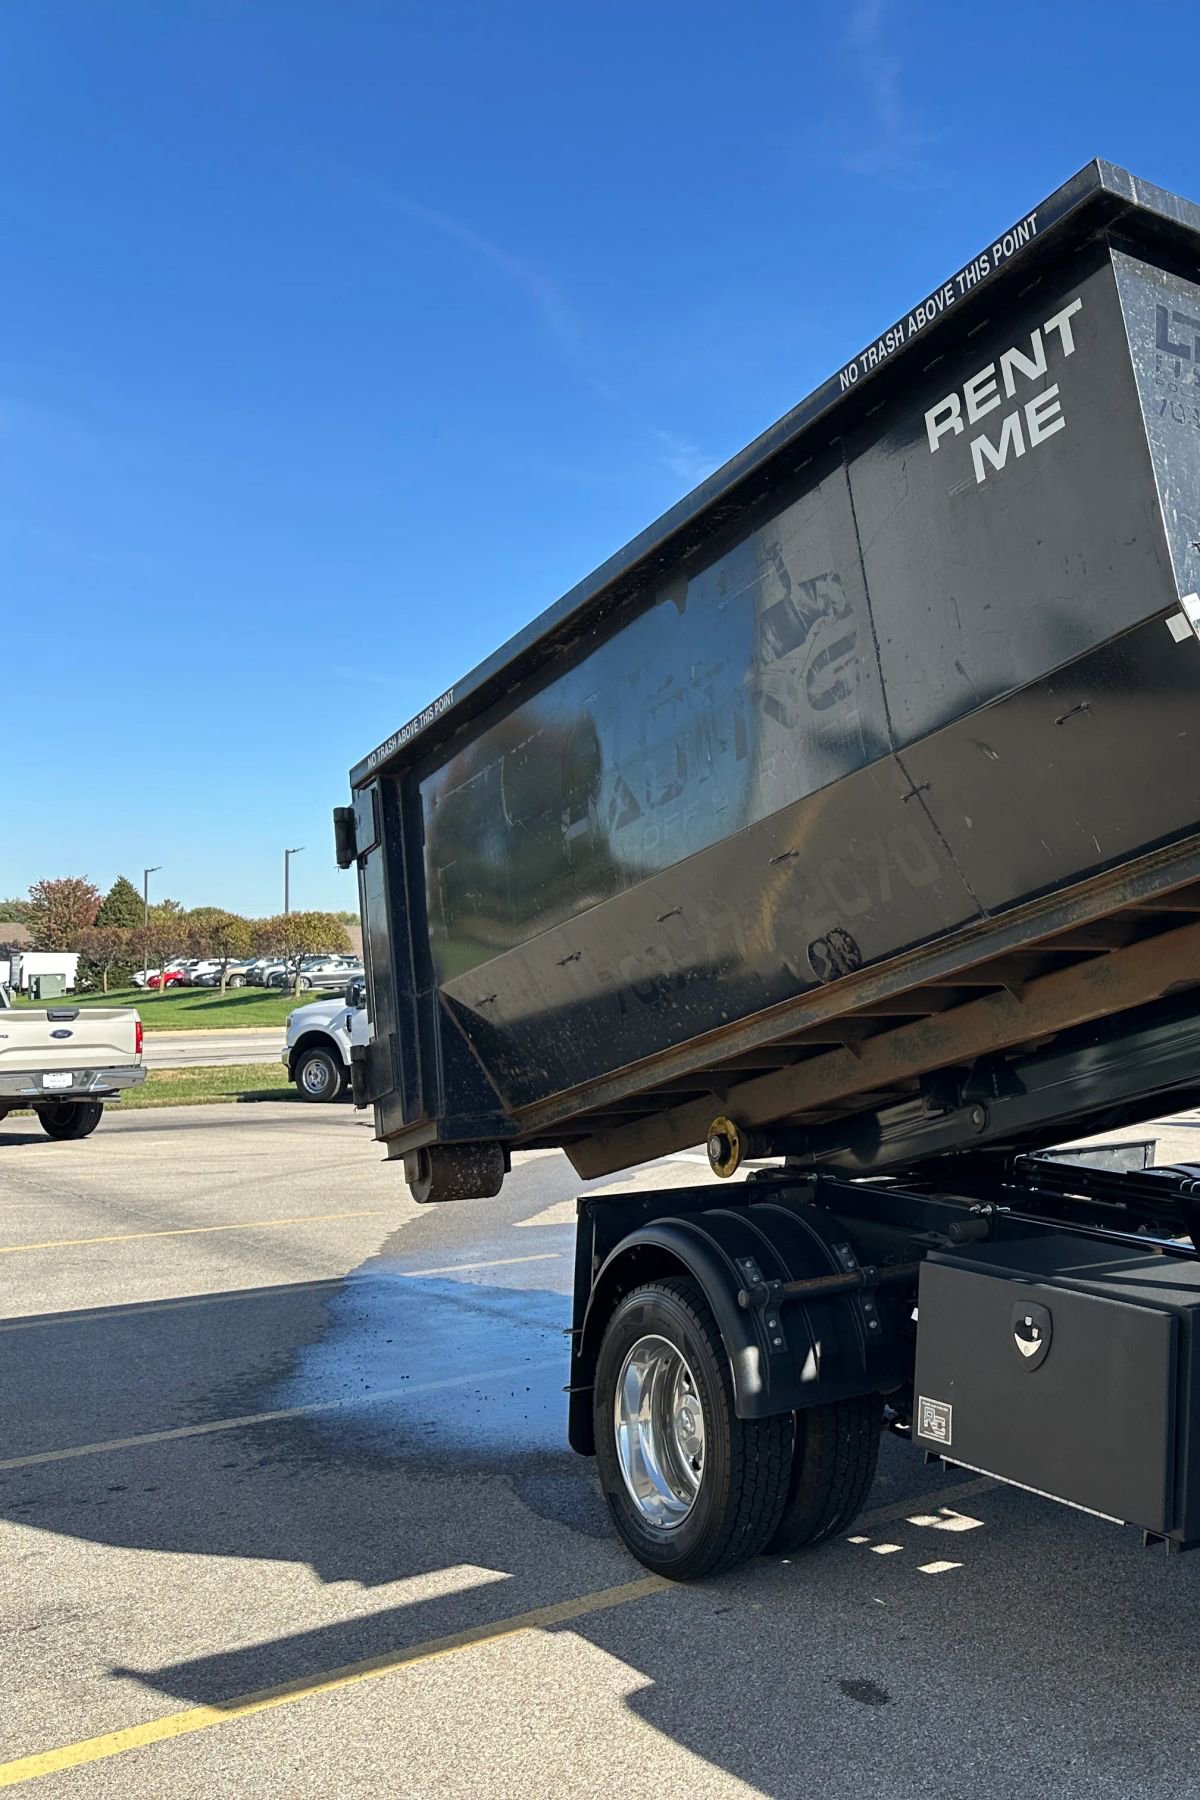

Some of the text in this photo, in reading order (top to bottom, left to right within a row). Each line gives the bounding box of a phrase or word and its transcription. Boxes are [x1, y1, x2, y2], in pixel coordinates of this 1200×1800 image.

[838, 212, 1038, 391] NO TRASH ABOVE THIS POINT
[924, 297, 1083, 453] RENT
[969, 382, 1066, 484] ME
[367, 689, 455, 770] NO TRASH ABOVE THIS POINT
